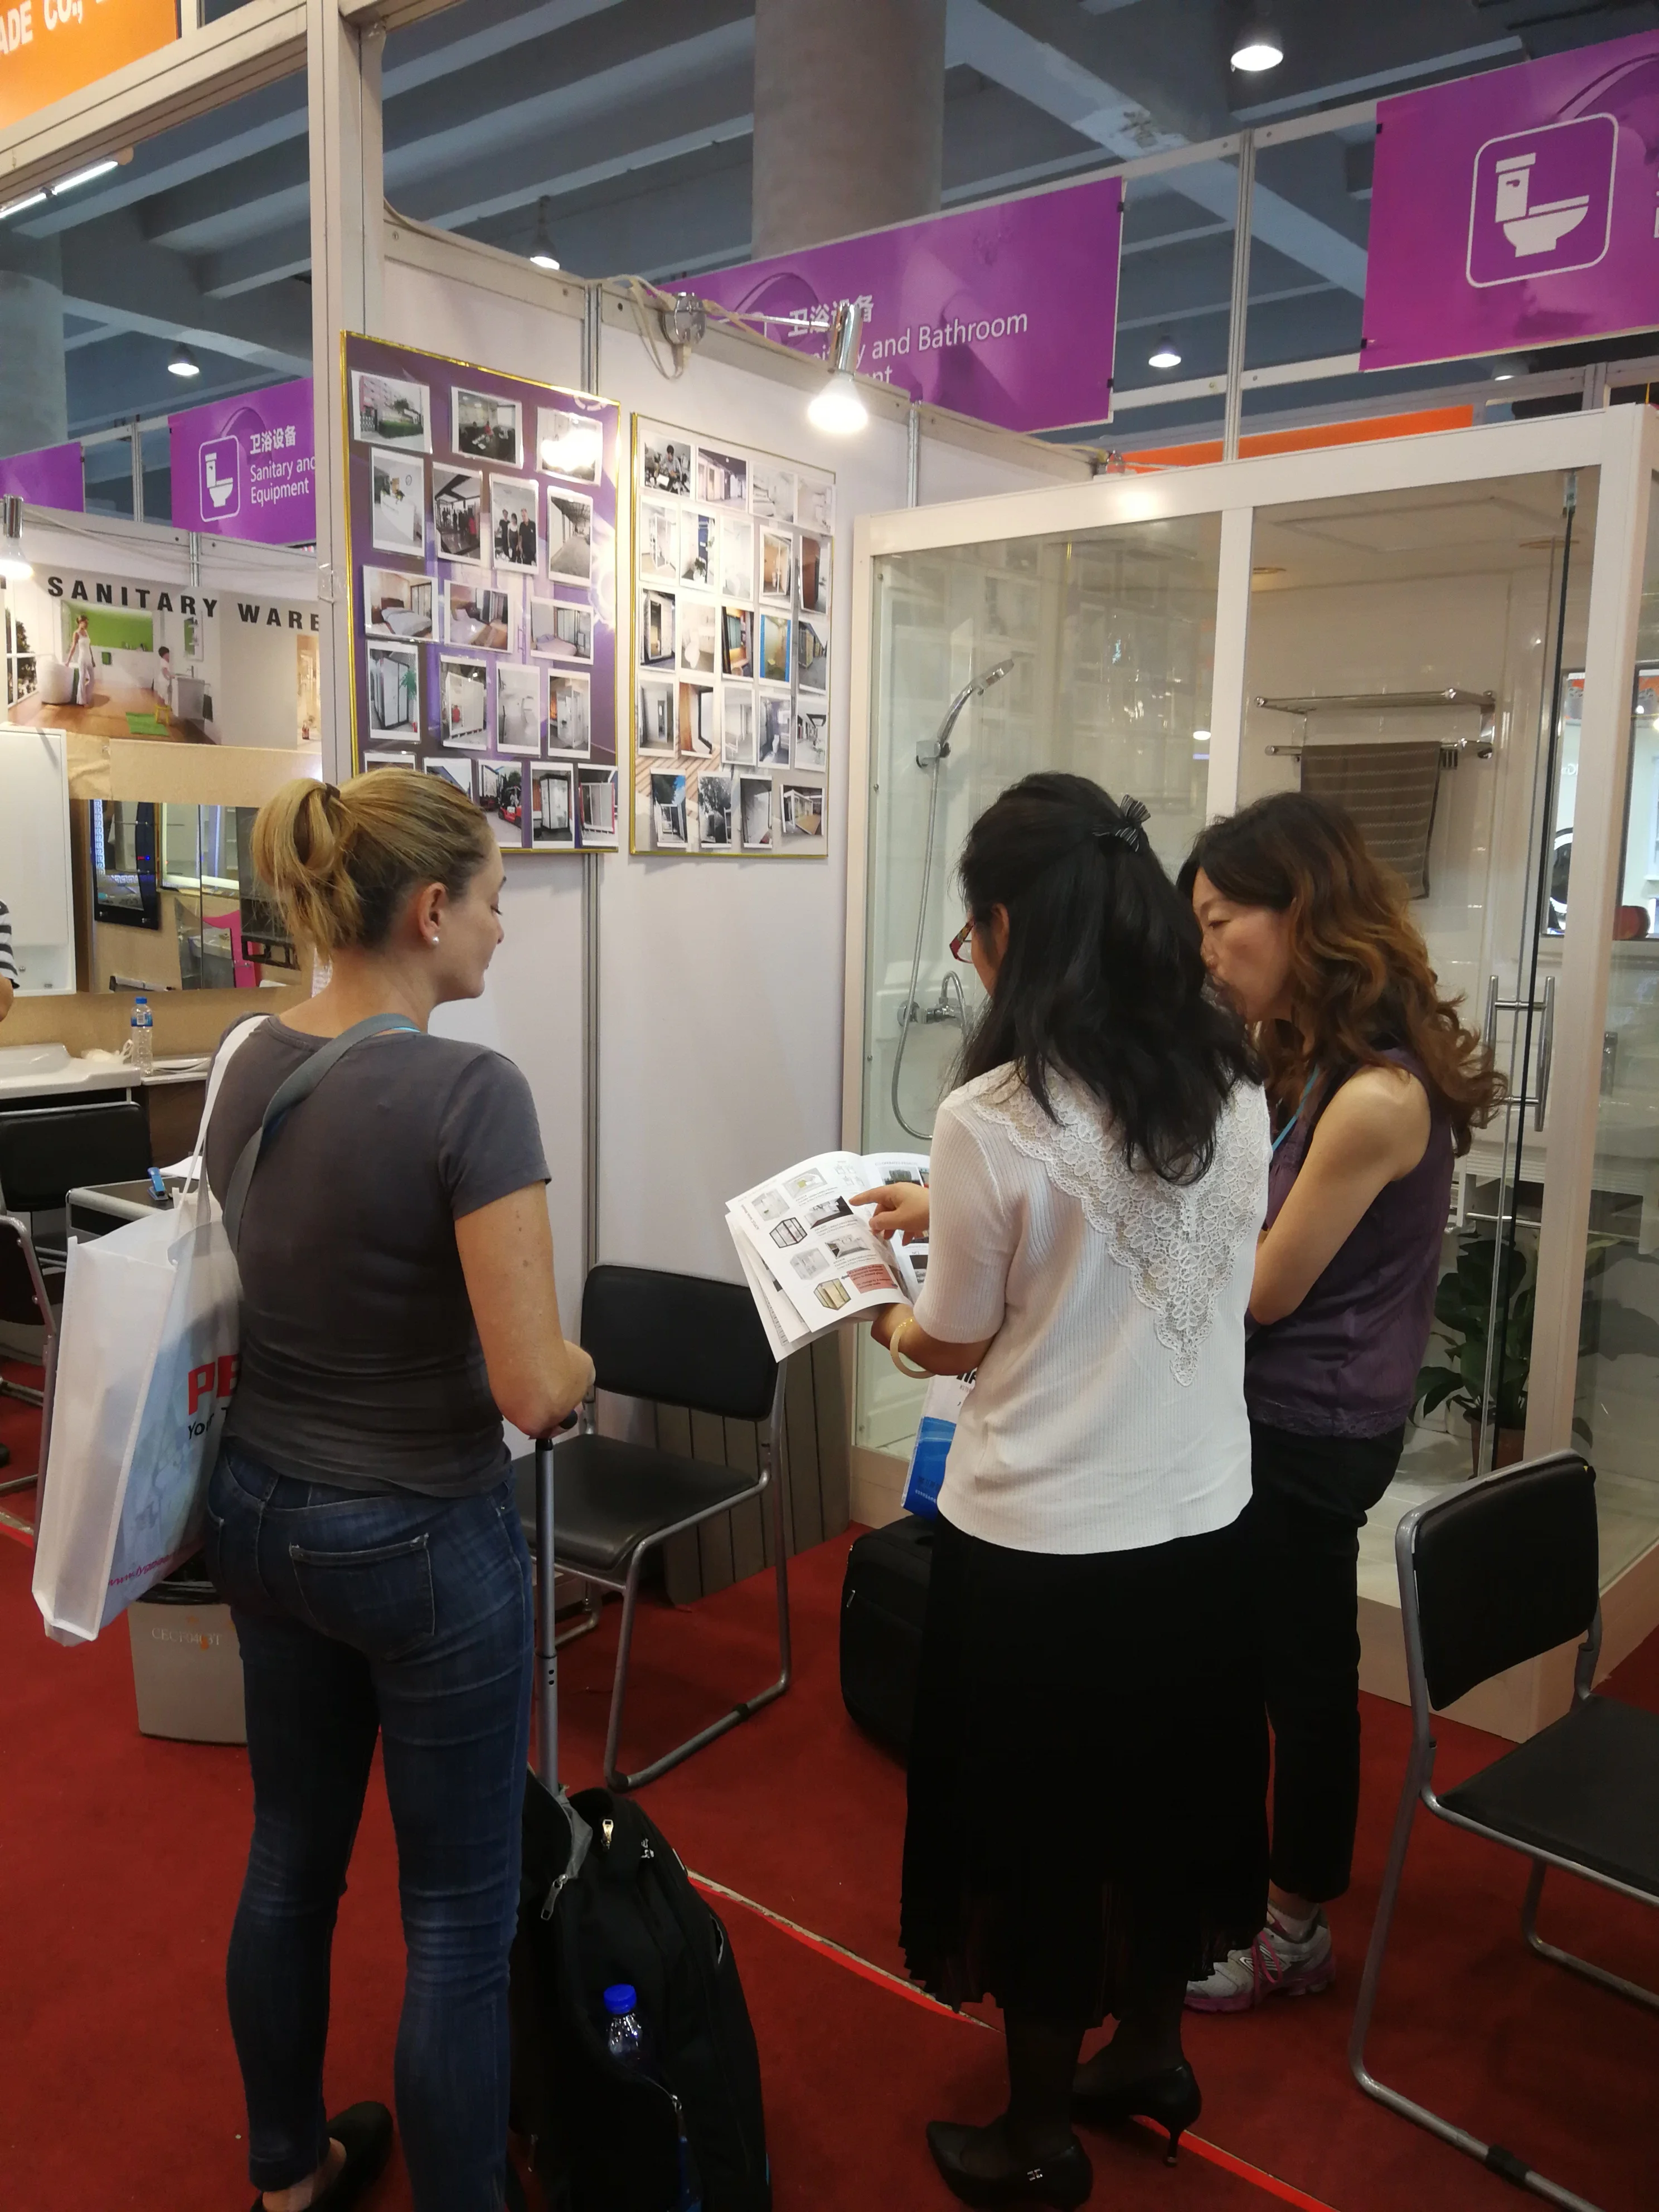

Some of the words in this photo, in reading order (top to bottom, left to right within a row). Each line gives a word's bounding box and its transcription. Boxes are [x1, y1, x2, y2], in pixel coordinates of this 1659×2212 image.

[872, 334, 910, 360] and
[918, 313, 1027, 352] Bathroom
[250, 425, 296, 454] 卫浴设备
[250, 460, 293, 482] Sanitary
[251, 477, 309, 507] Equipment
[48, 576, 217, 617] SANITARY
